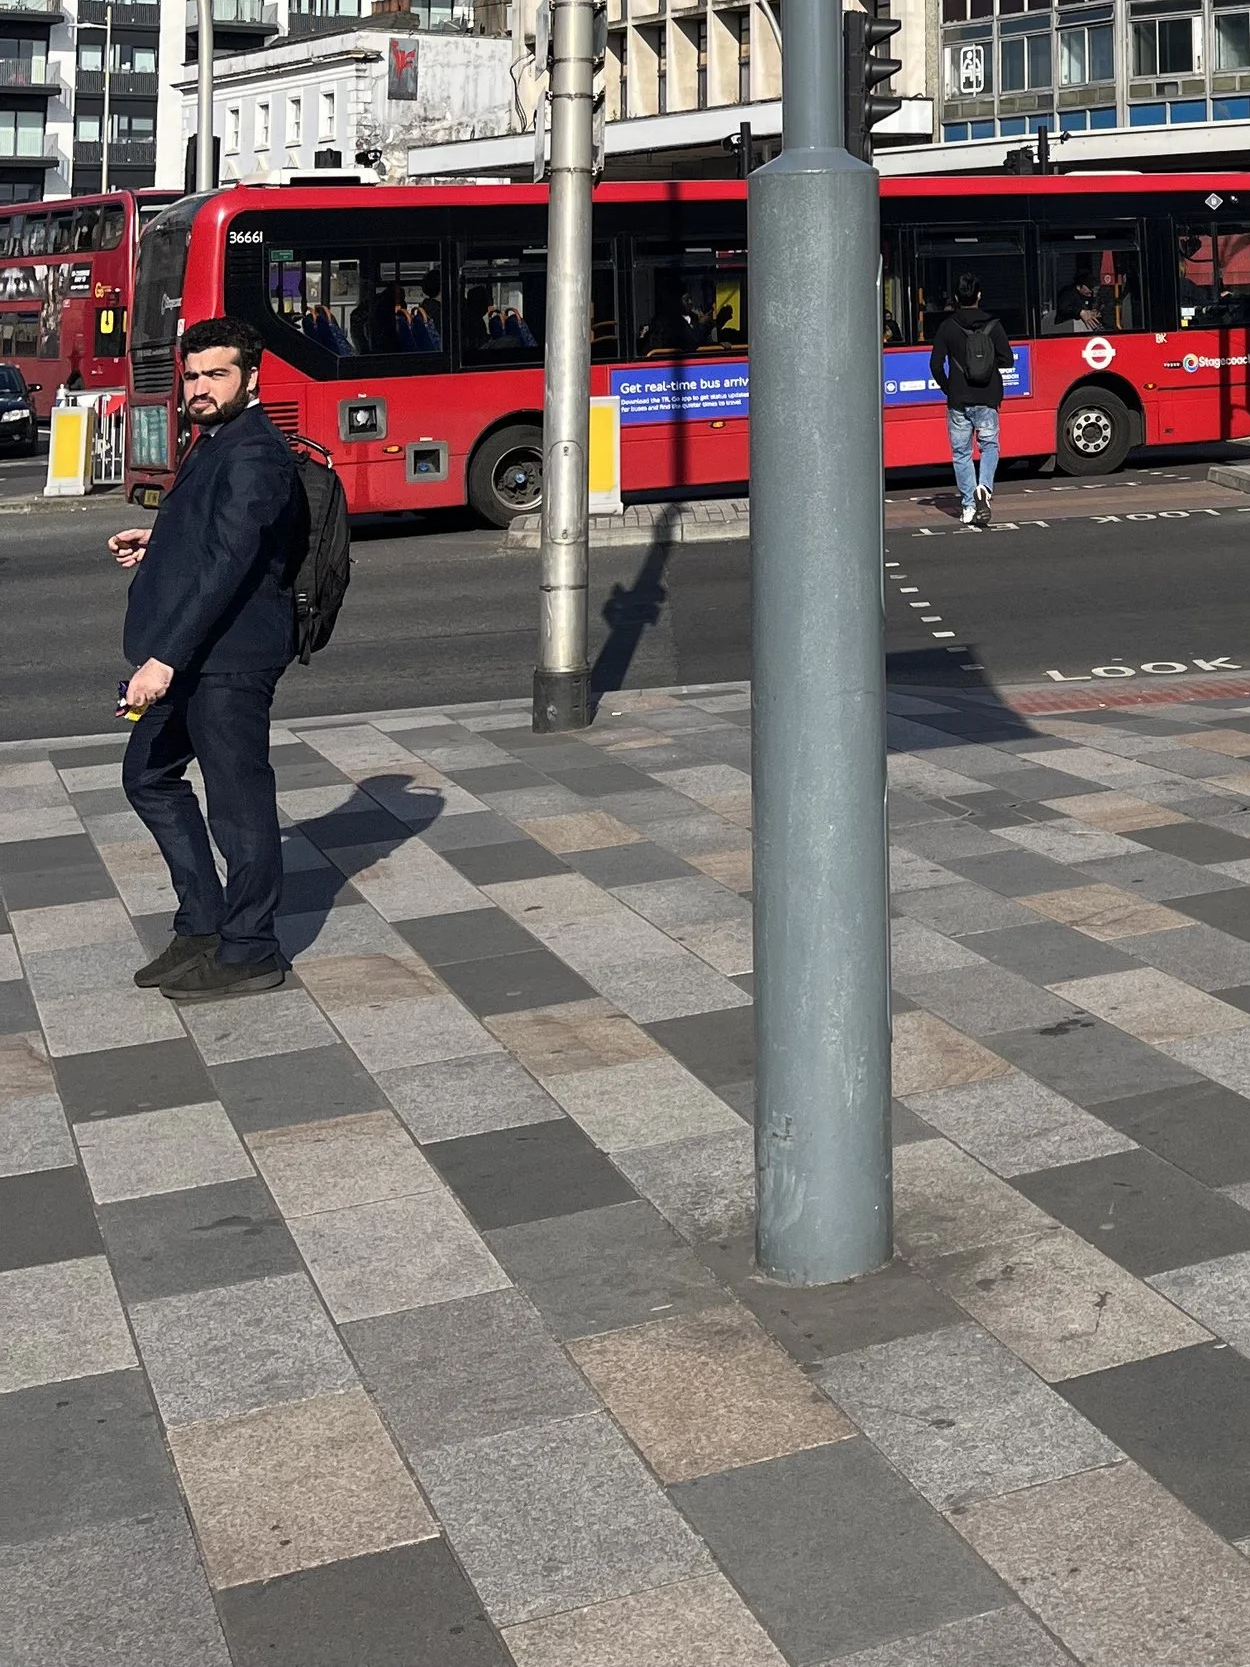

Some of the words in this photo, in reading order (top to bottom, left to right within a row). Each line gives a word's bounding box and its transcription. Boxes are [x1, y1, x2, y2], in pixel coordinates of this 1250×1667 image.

[229, 230, 264, 244] 36661
[620, 382, 642, 394] Get
[645, 380, 697, 392] real-time
[700, 377, 721, 389] bus
[724, 376, 749, 387] arriv
[1089, 509, 1221, 524] LOOK
[1046, 656, 1242, 684] LOOK
